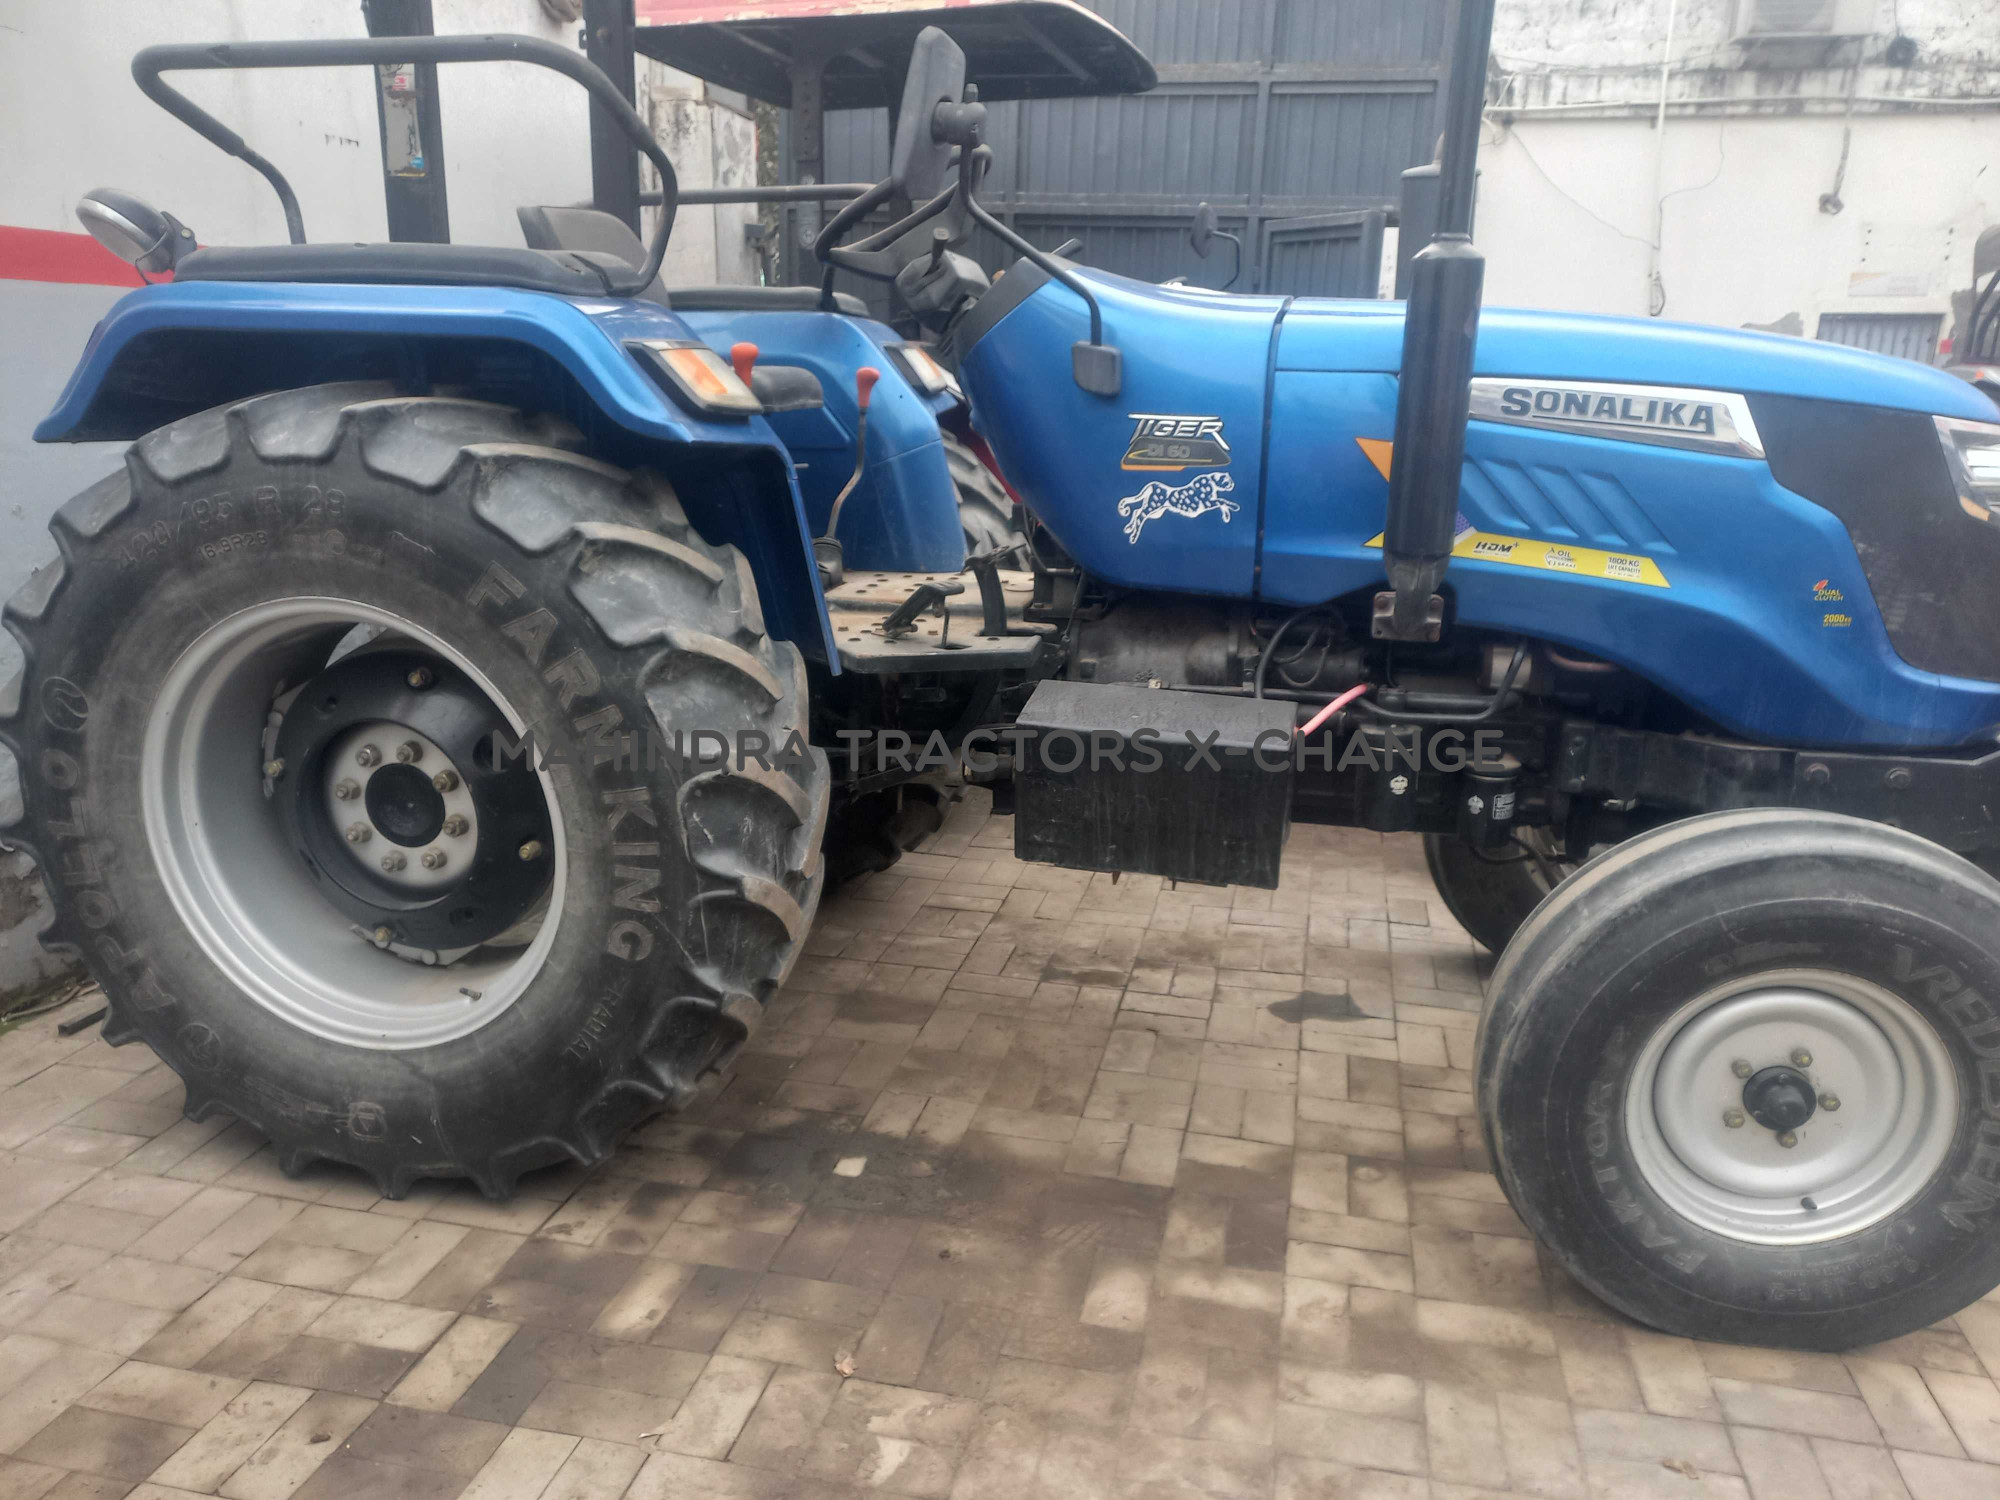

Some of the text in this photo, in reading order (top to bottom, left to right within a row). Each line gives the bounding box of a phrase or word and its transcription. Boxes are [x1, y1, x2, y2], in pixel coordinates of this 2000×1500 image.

[1500, 387, 1716, 436] SONALIKA
[1128, 413, 1231, 451] TIGER
[1167, 444, 1191, 459] 60
[255, 485, 283, 515] R
